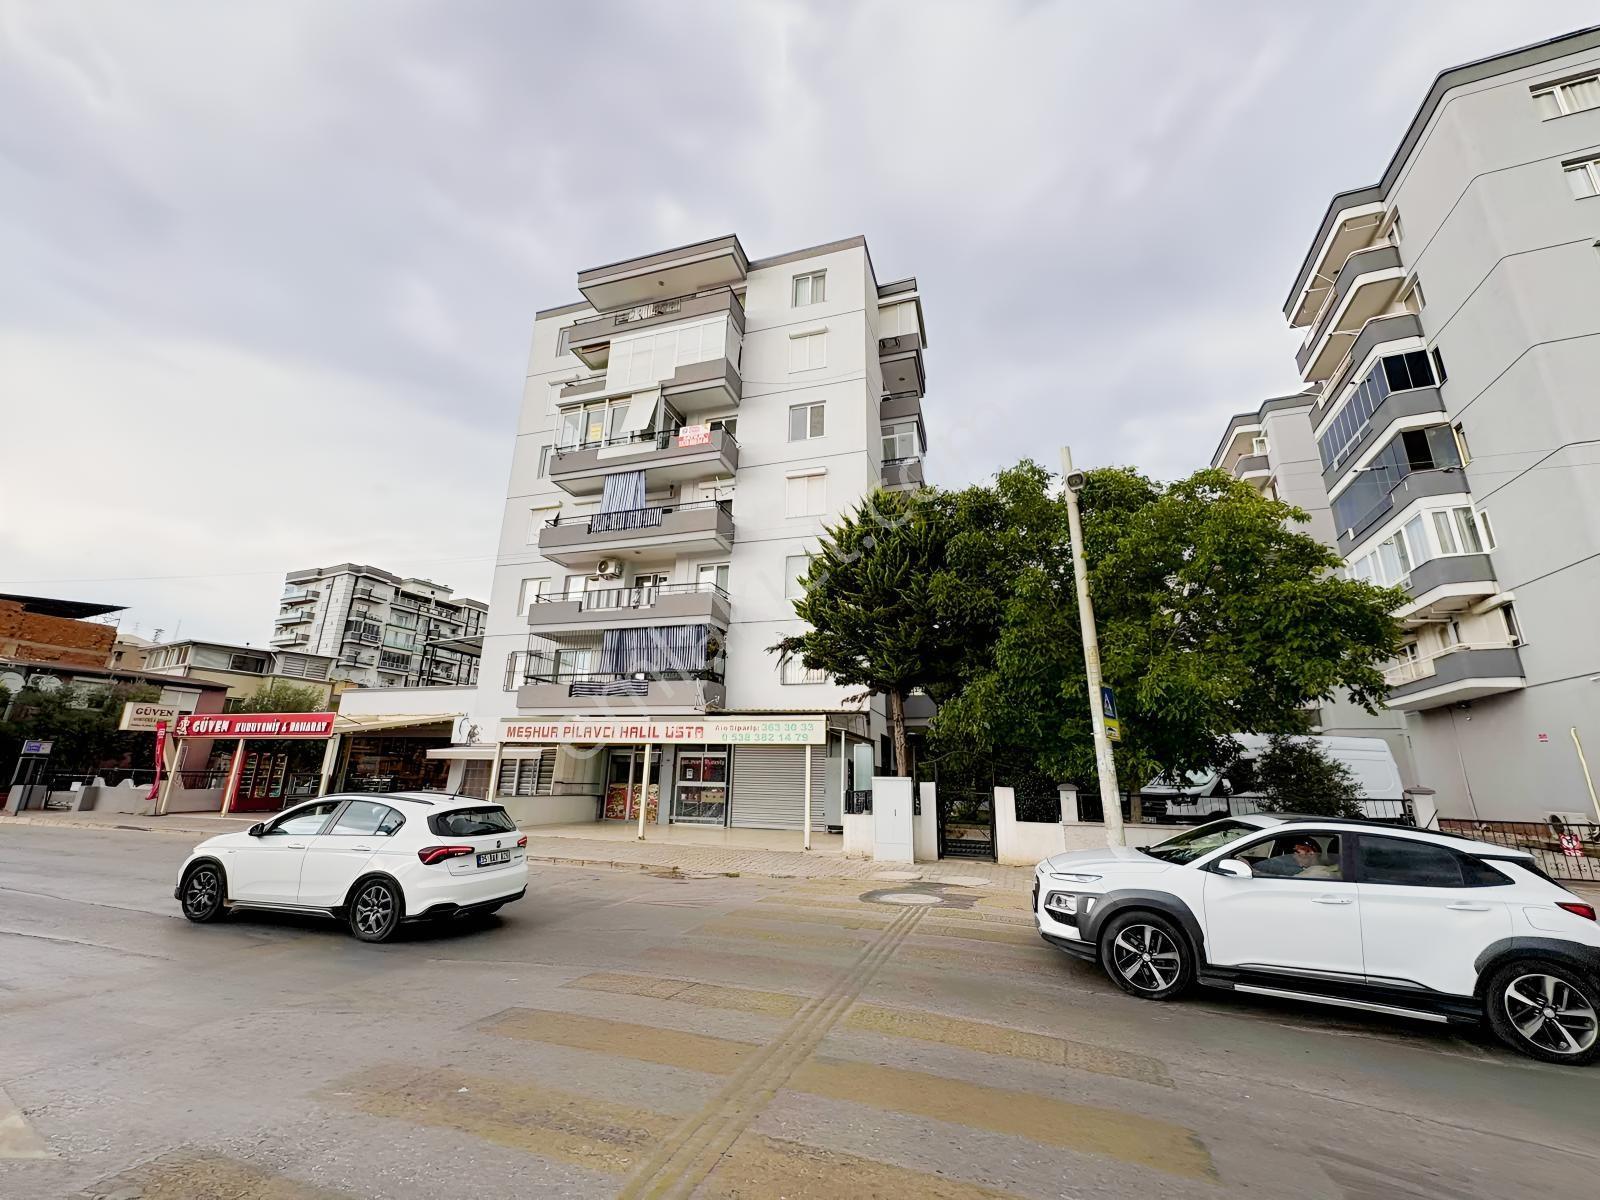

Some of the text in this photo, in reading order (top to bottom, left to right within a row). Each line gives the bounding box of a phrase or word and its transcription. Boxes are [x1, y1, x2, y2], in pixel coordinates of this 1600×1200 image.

[136, 707, 174, 717] GÜVEN
[192, 717, 230, 733] GÜVEN
[762, 723, 781, 732] 363
[800, 723, 815, 731] 33
[506, 725, 558, 740] MEŞHUR
[562, 723, 615, 739] PİLAVCI
[620, 723, 660, 738] HALİL
[721, 733, 728, 742] 0
[731, 733, 752, 742] 538
[754, 733, 775, 742] 382
[779, 733, 792, 741] 14
